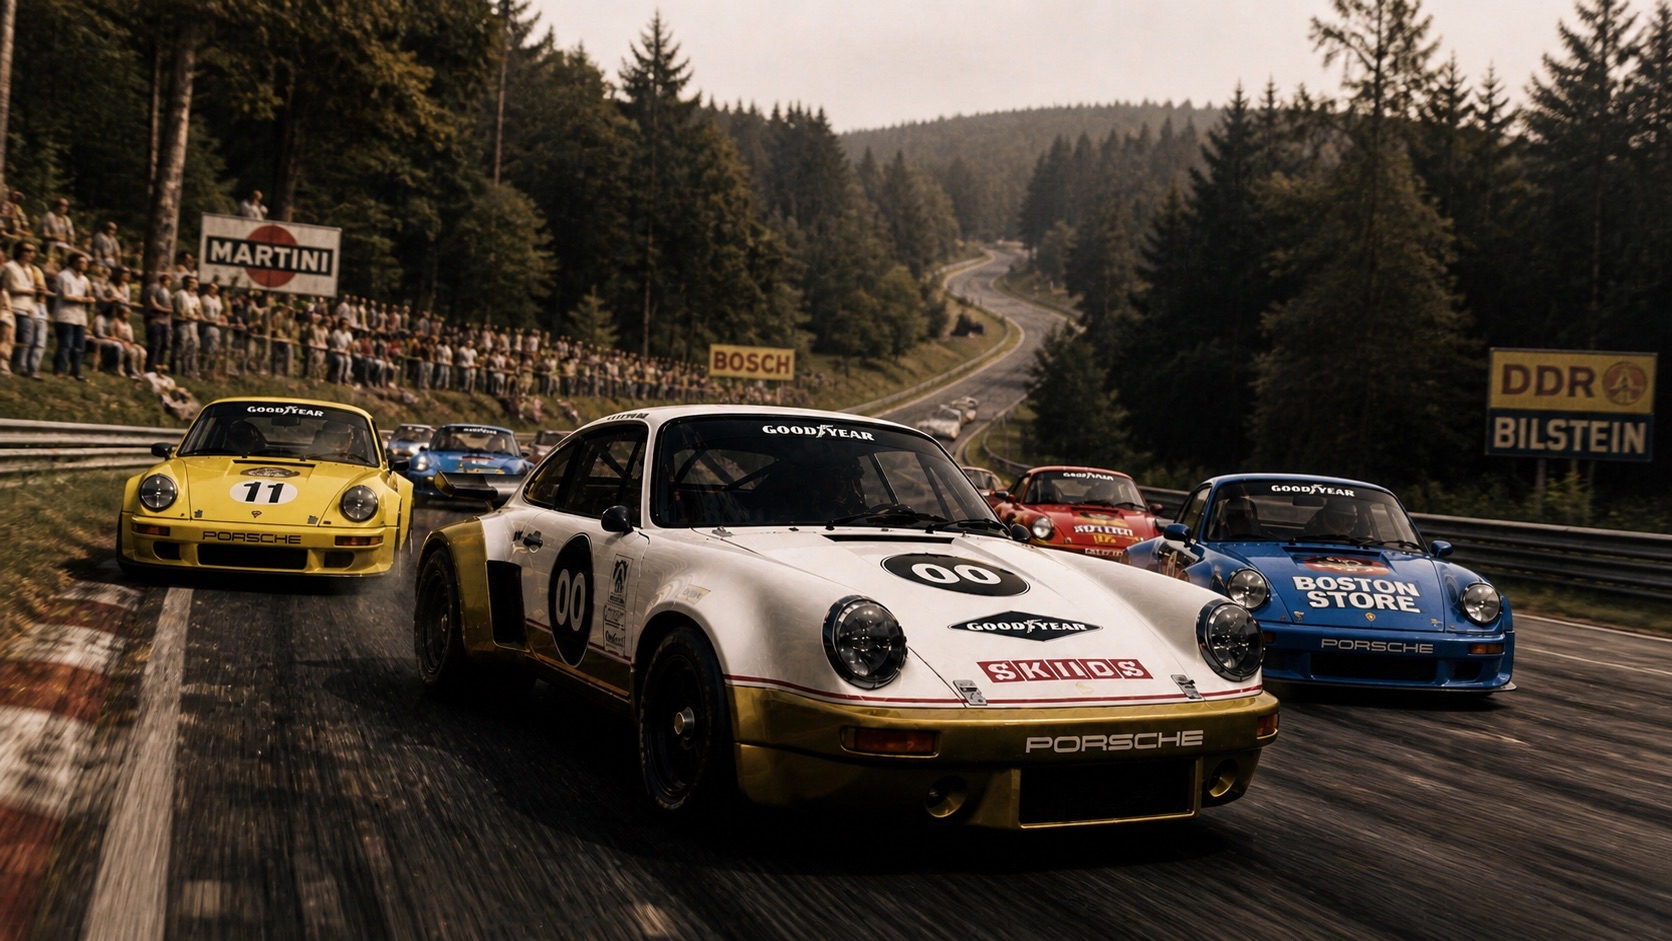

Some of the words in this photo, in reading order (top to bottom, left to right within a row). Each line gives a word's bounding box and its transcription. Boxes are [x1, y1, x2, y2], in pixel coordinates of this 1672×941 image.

[211, 240, 328, 273] MARTINI
[713, 351, 790, 375] BOSCH
[1502, 364, 1596, 398] DDR
[247, 405, 324, 417] GOODYEAR
[762, 424, 875, 441] GOODYEAR
[1493, 416, 1647, 454] BILSTEIN
[243, 481, 284, 504] 11
[1271, 484, 1355, 497] GOODYEAR
[202, 531, 301, 544] PORSCHE
[911, 563, 1002, 585] 00
[1292, 576, 1421, 597] BOSTON
[555, 568, 586, 632] 00
[1307, 591, 1421, 613] STORE
[966, 618, 1087, 634] GOODYEAR
[1321, 639, 1433, 653] PORSCHE
[1025, 730, 1204, 754] PORSCHE
